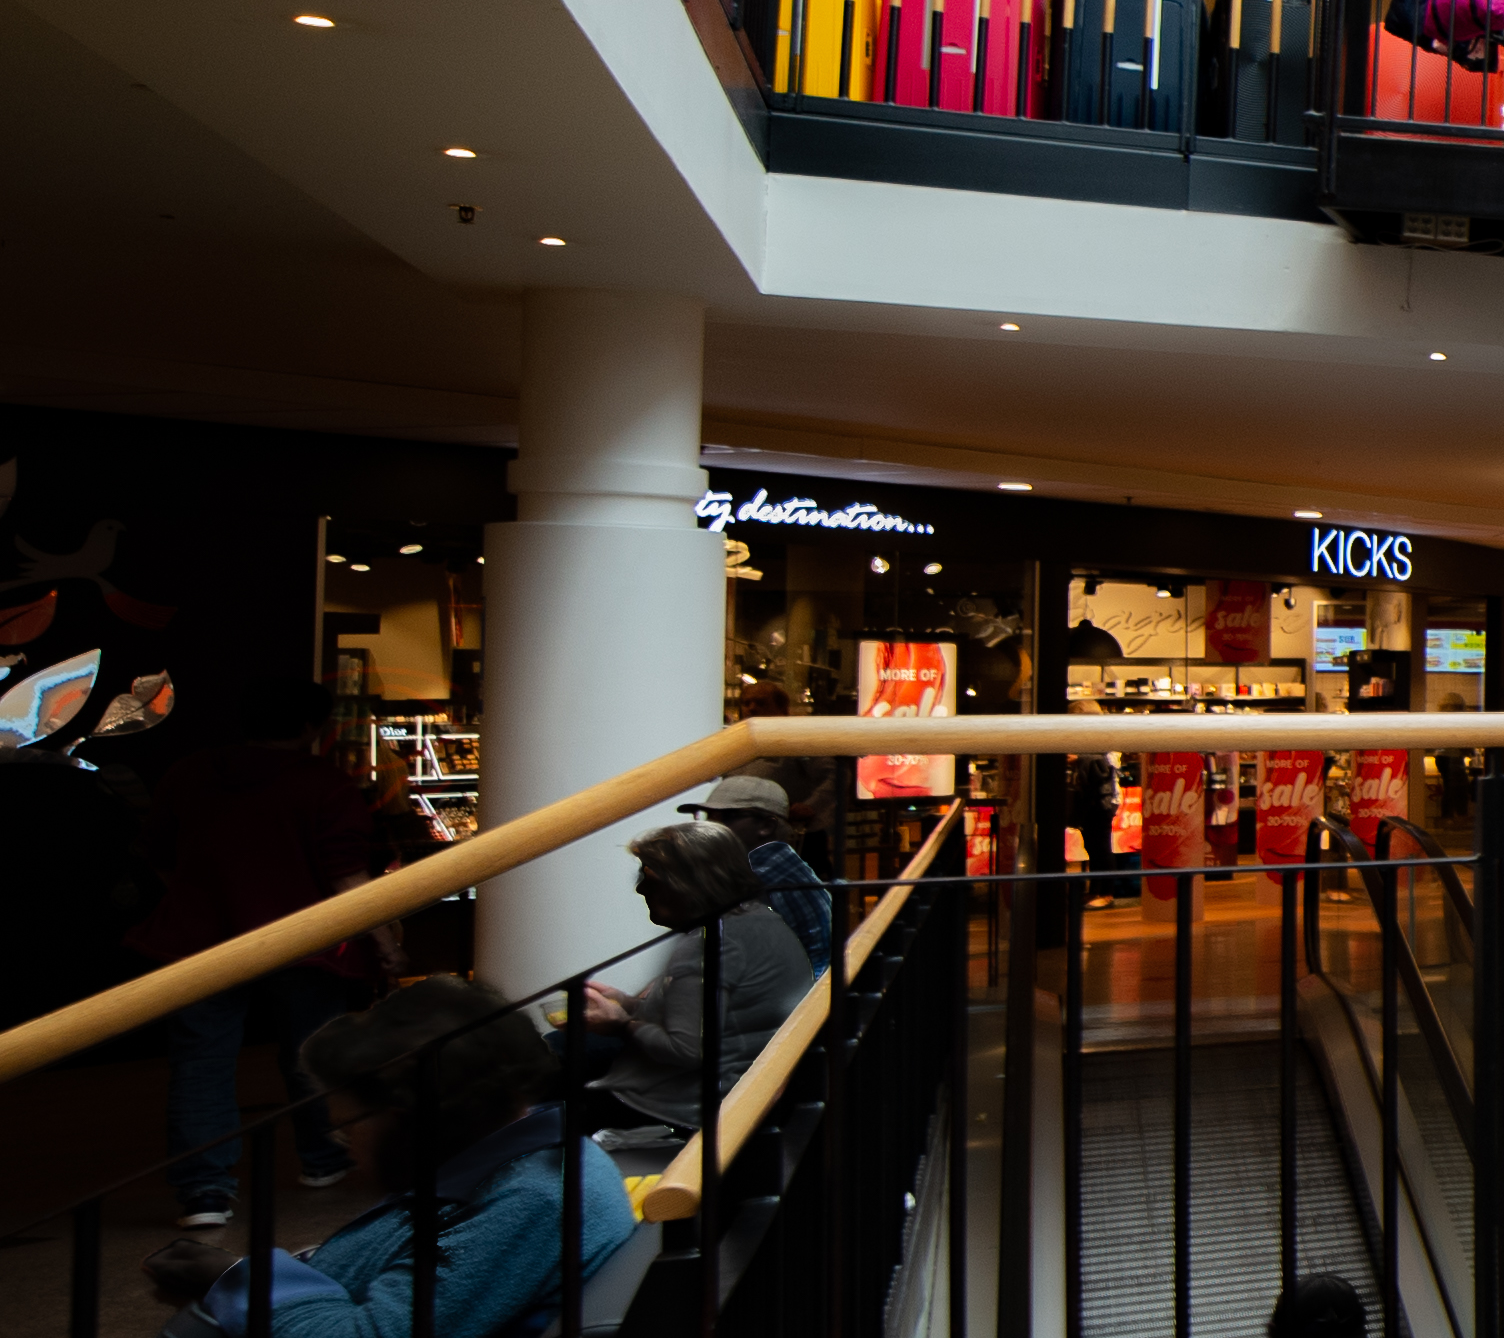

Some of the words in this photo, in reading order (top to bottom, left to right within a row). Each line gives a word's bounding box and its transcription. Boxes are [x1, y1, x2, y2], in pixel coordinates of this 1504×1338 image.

[1311, 526, 1413, 582] KICKS
[879, 668, 917, 682] MORE
[920, 668, 939, 681] OF
[1265, 759, 1293, 770] MORE
[1294, 758, 1310, 769] OF
[1142, 777, 1198, 816] sale
[1259, 772, 1322, 811] sale
[1352, 766, 1402, 803] sale
